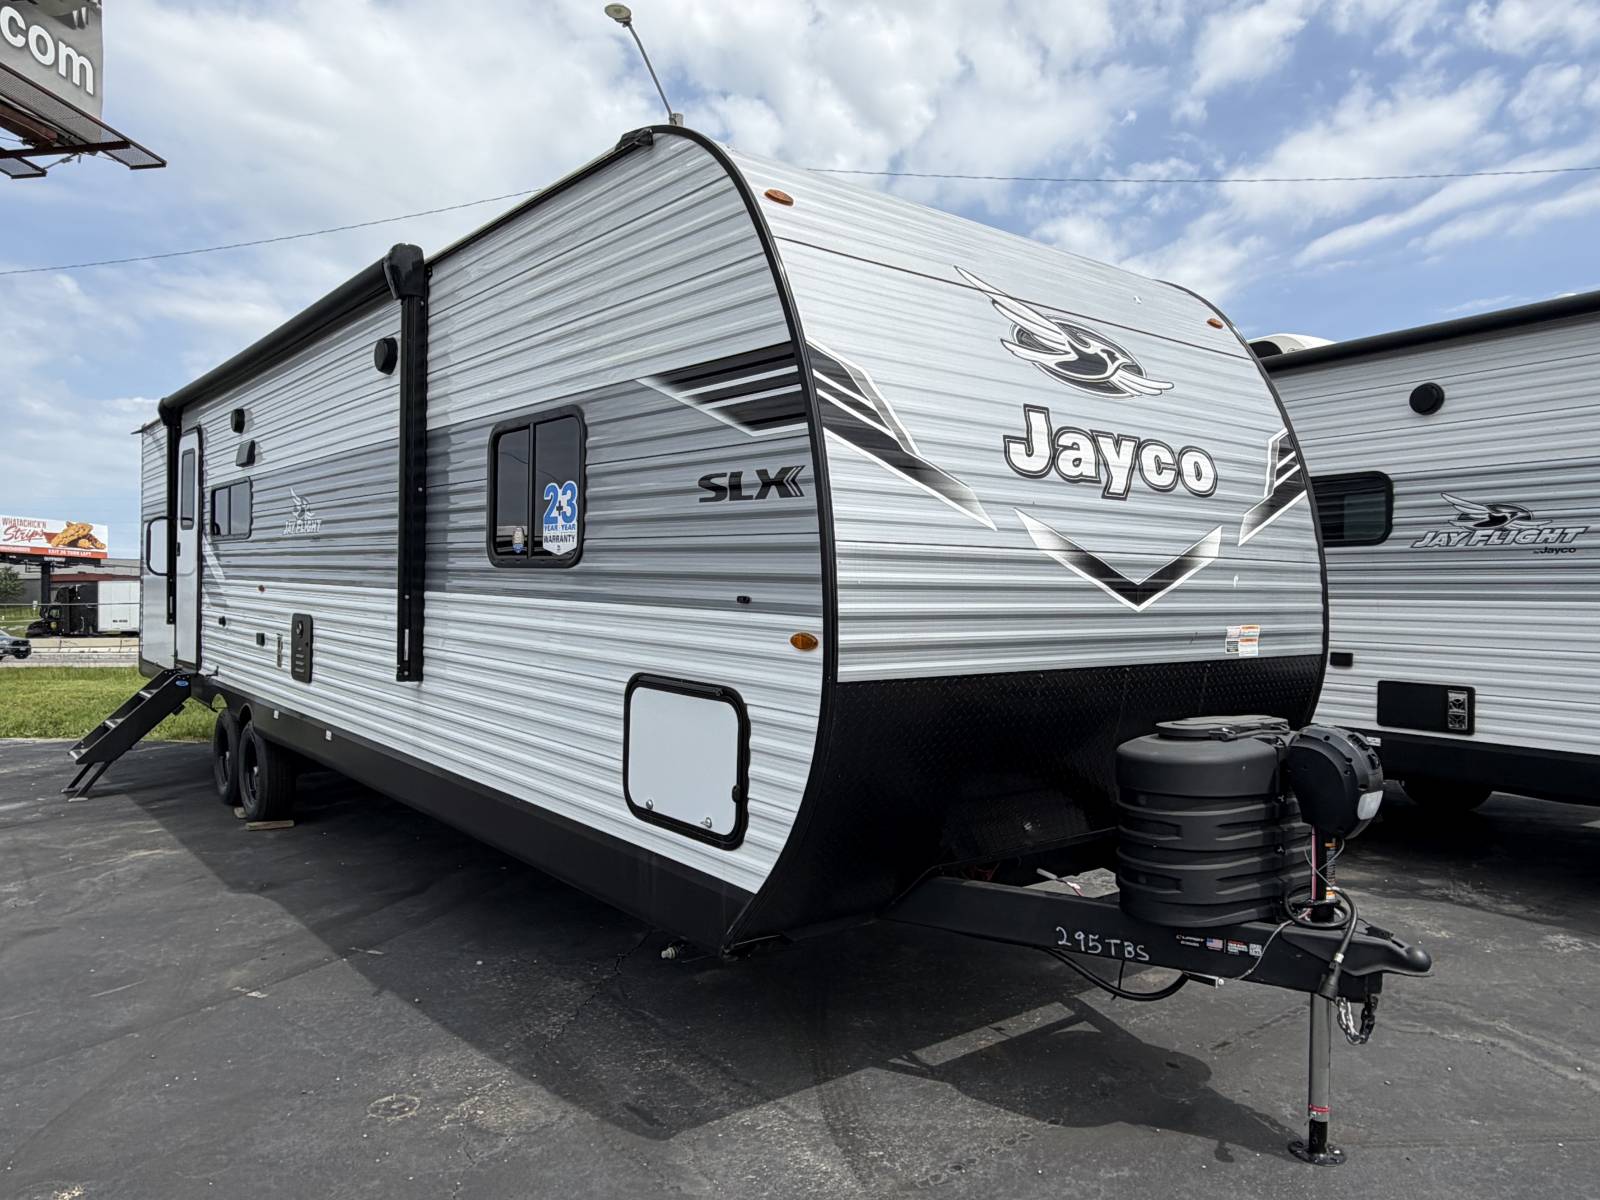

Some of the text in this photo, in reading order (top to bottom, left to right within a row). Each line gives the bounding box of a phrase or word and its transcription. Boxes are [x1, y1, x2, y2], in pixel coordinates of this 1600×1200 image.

[1003, 403, 1218, 501] Jayco
[698, 465, 805, 503] SLX
[561, 523, 576, 531] YEAR
[543, 534, 576, 543] WARRANTY
[1410, 526, 1590, 548] JAY FLIGHT
[1540, 546, 1577, 555] Jayco
